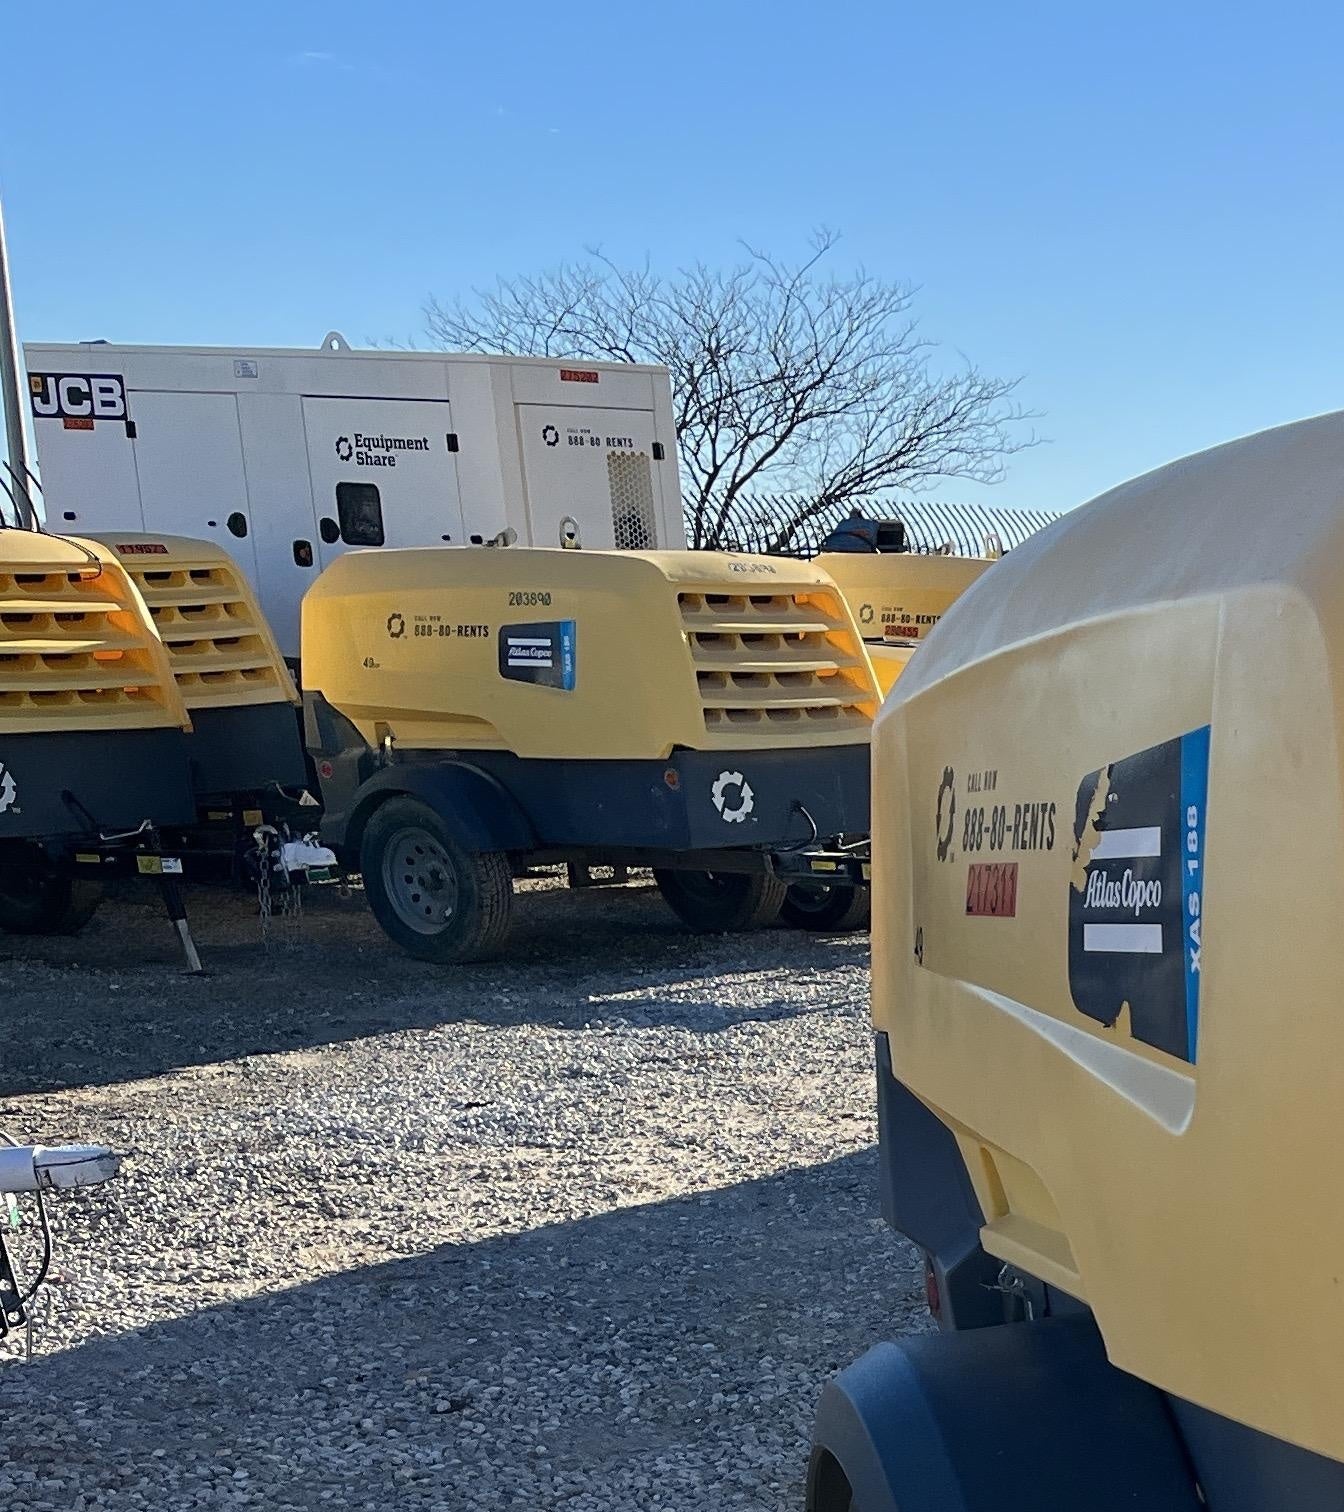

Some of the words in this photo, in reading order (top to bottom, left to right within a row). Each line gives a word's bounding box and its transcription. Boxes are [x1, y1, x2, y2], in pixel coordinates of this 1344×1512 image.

[33, 376, 125, 416] JCB
[353, 433, 430, 453] Equipment
[355, 452, 397, 467] Share
[414, 624, 490, 638] 888-80-RENTS
[967, 773, 982, 793] CALL
[983, 770, 998, 791] NOW
[963, 802, 1056, 852] 888-80-RENTS
[1186, 805, 1199, 878] 188
[1084, 869, 1121, 909] Atlas
[1121, 868, 1162, 917] Copco
[1187, 892, 1202, 974] XAS
